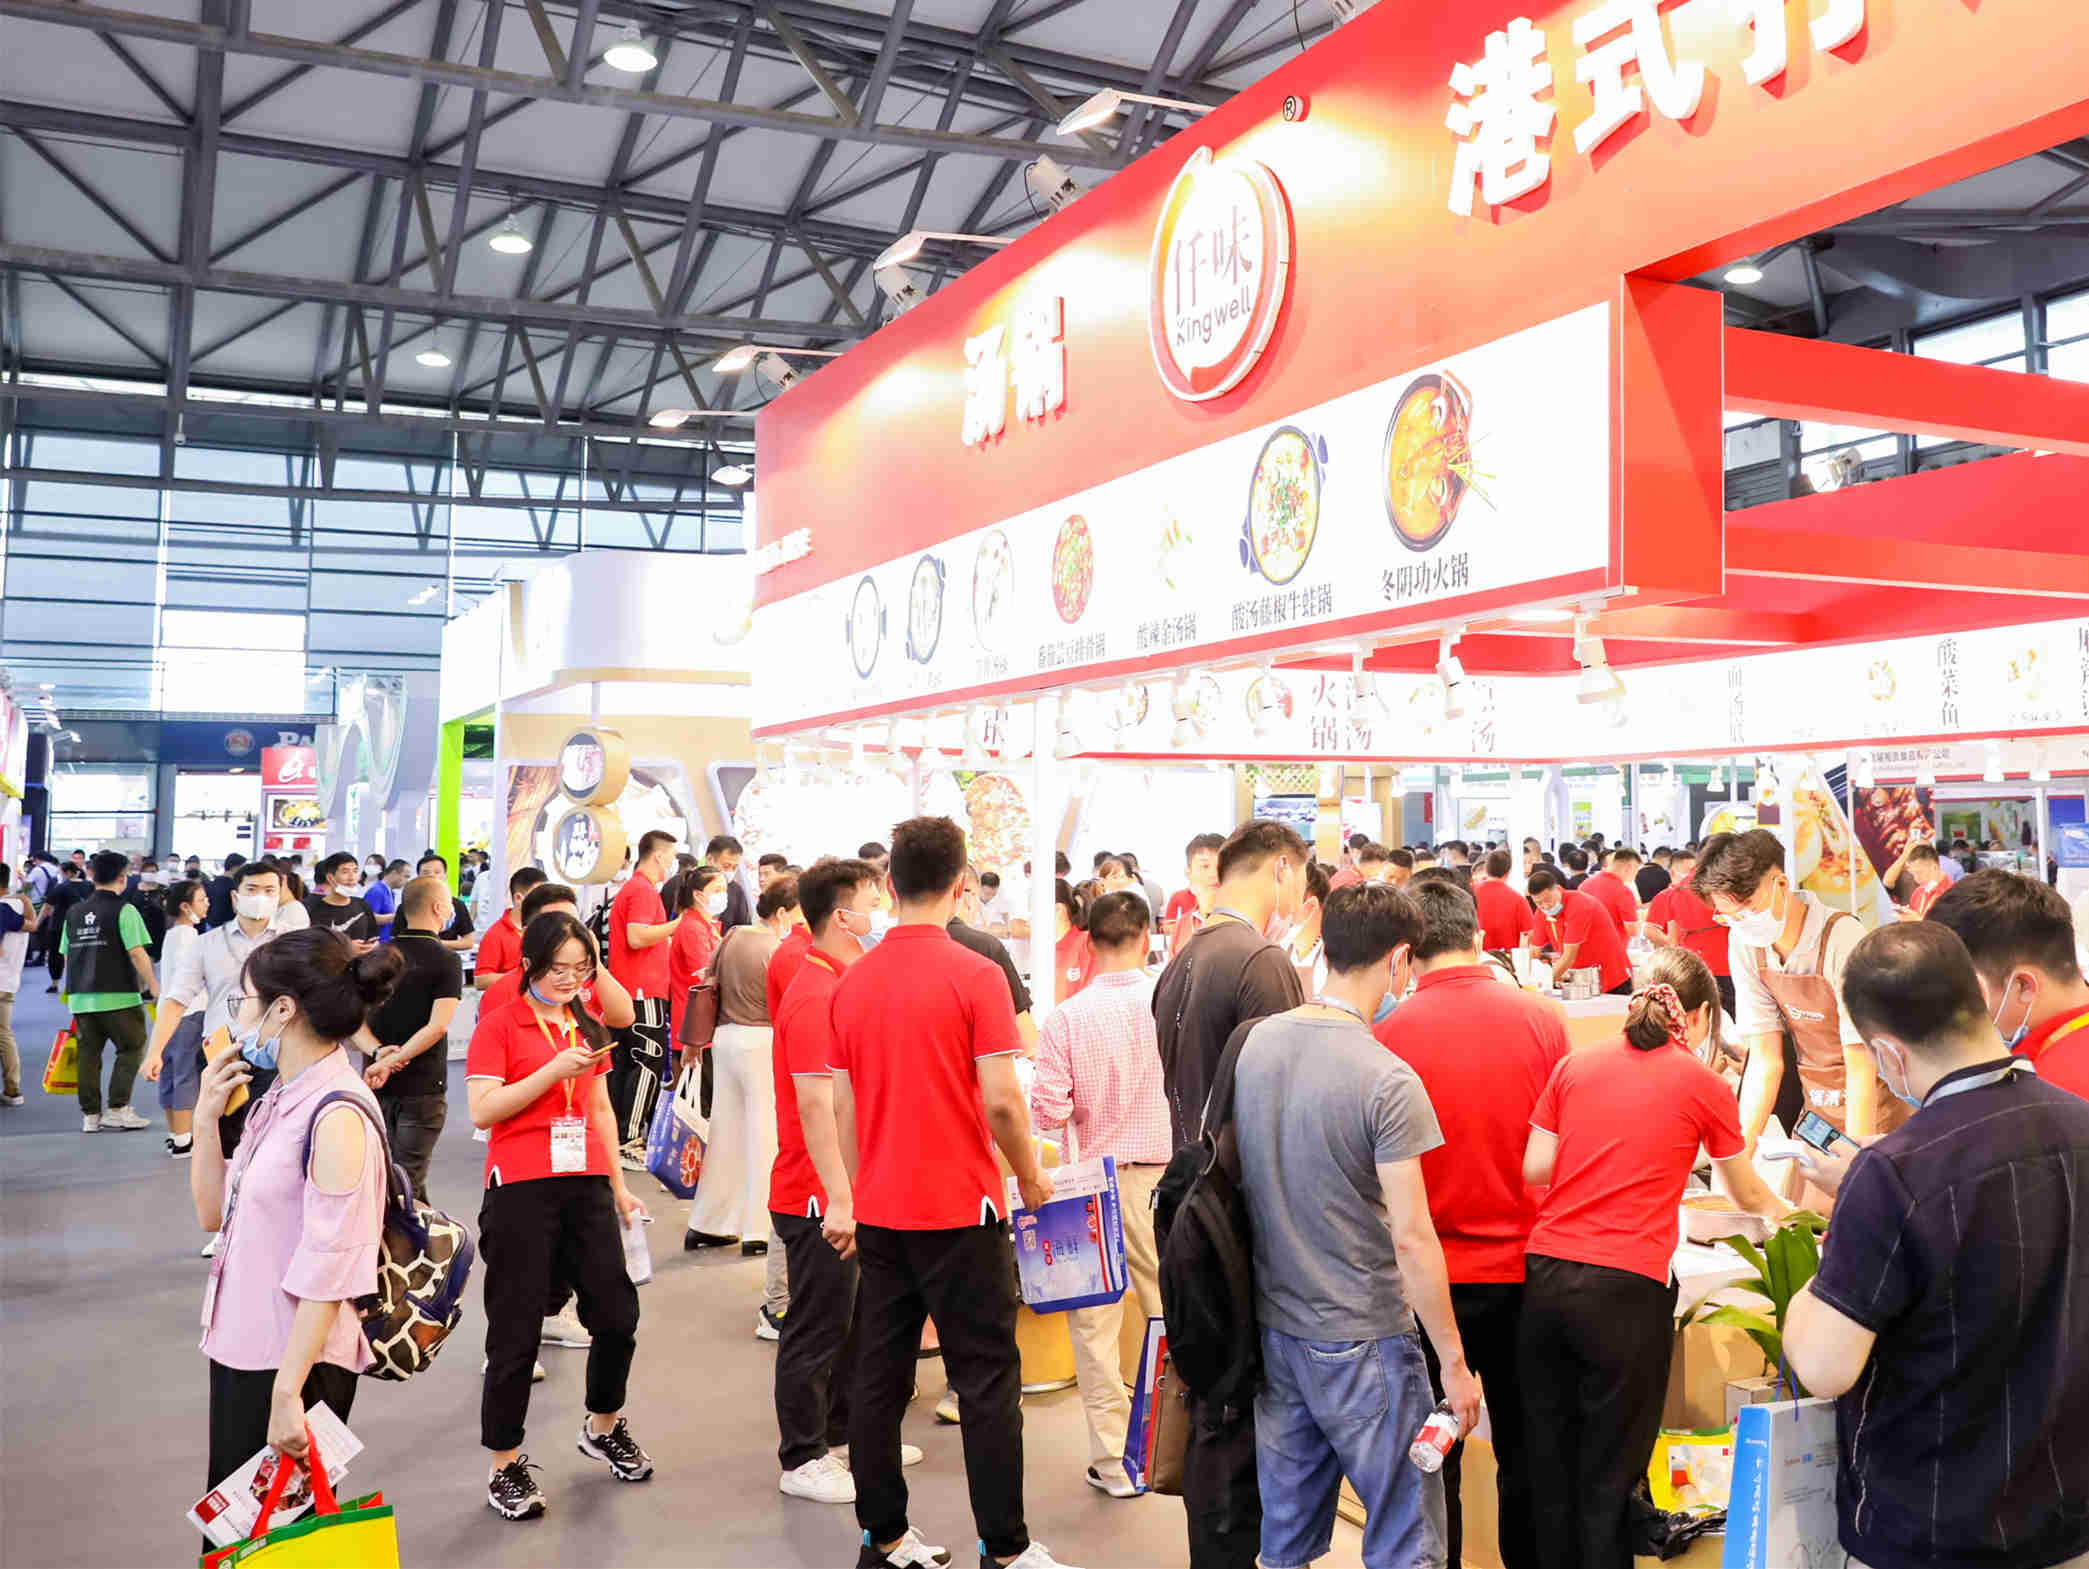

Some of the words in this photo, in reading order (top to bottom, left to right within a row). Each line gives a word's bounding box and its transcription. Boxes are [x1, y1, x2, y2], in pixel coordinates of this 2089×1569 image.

[1176, 285, 1251, 346] Kingwell
[1382, 552, 1469, 601] 冬阴功火锅
